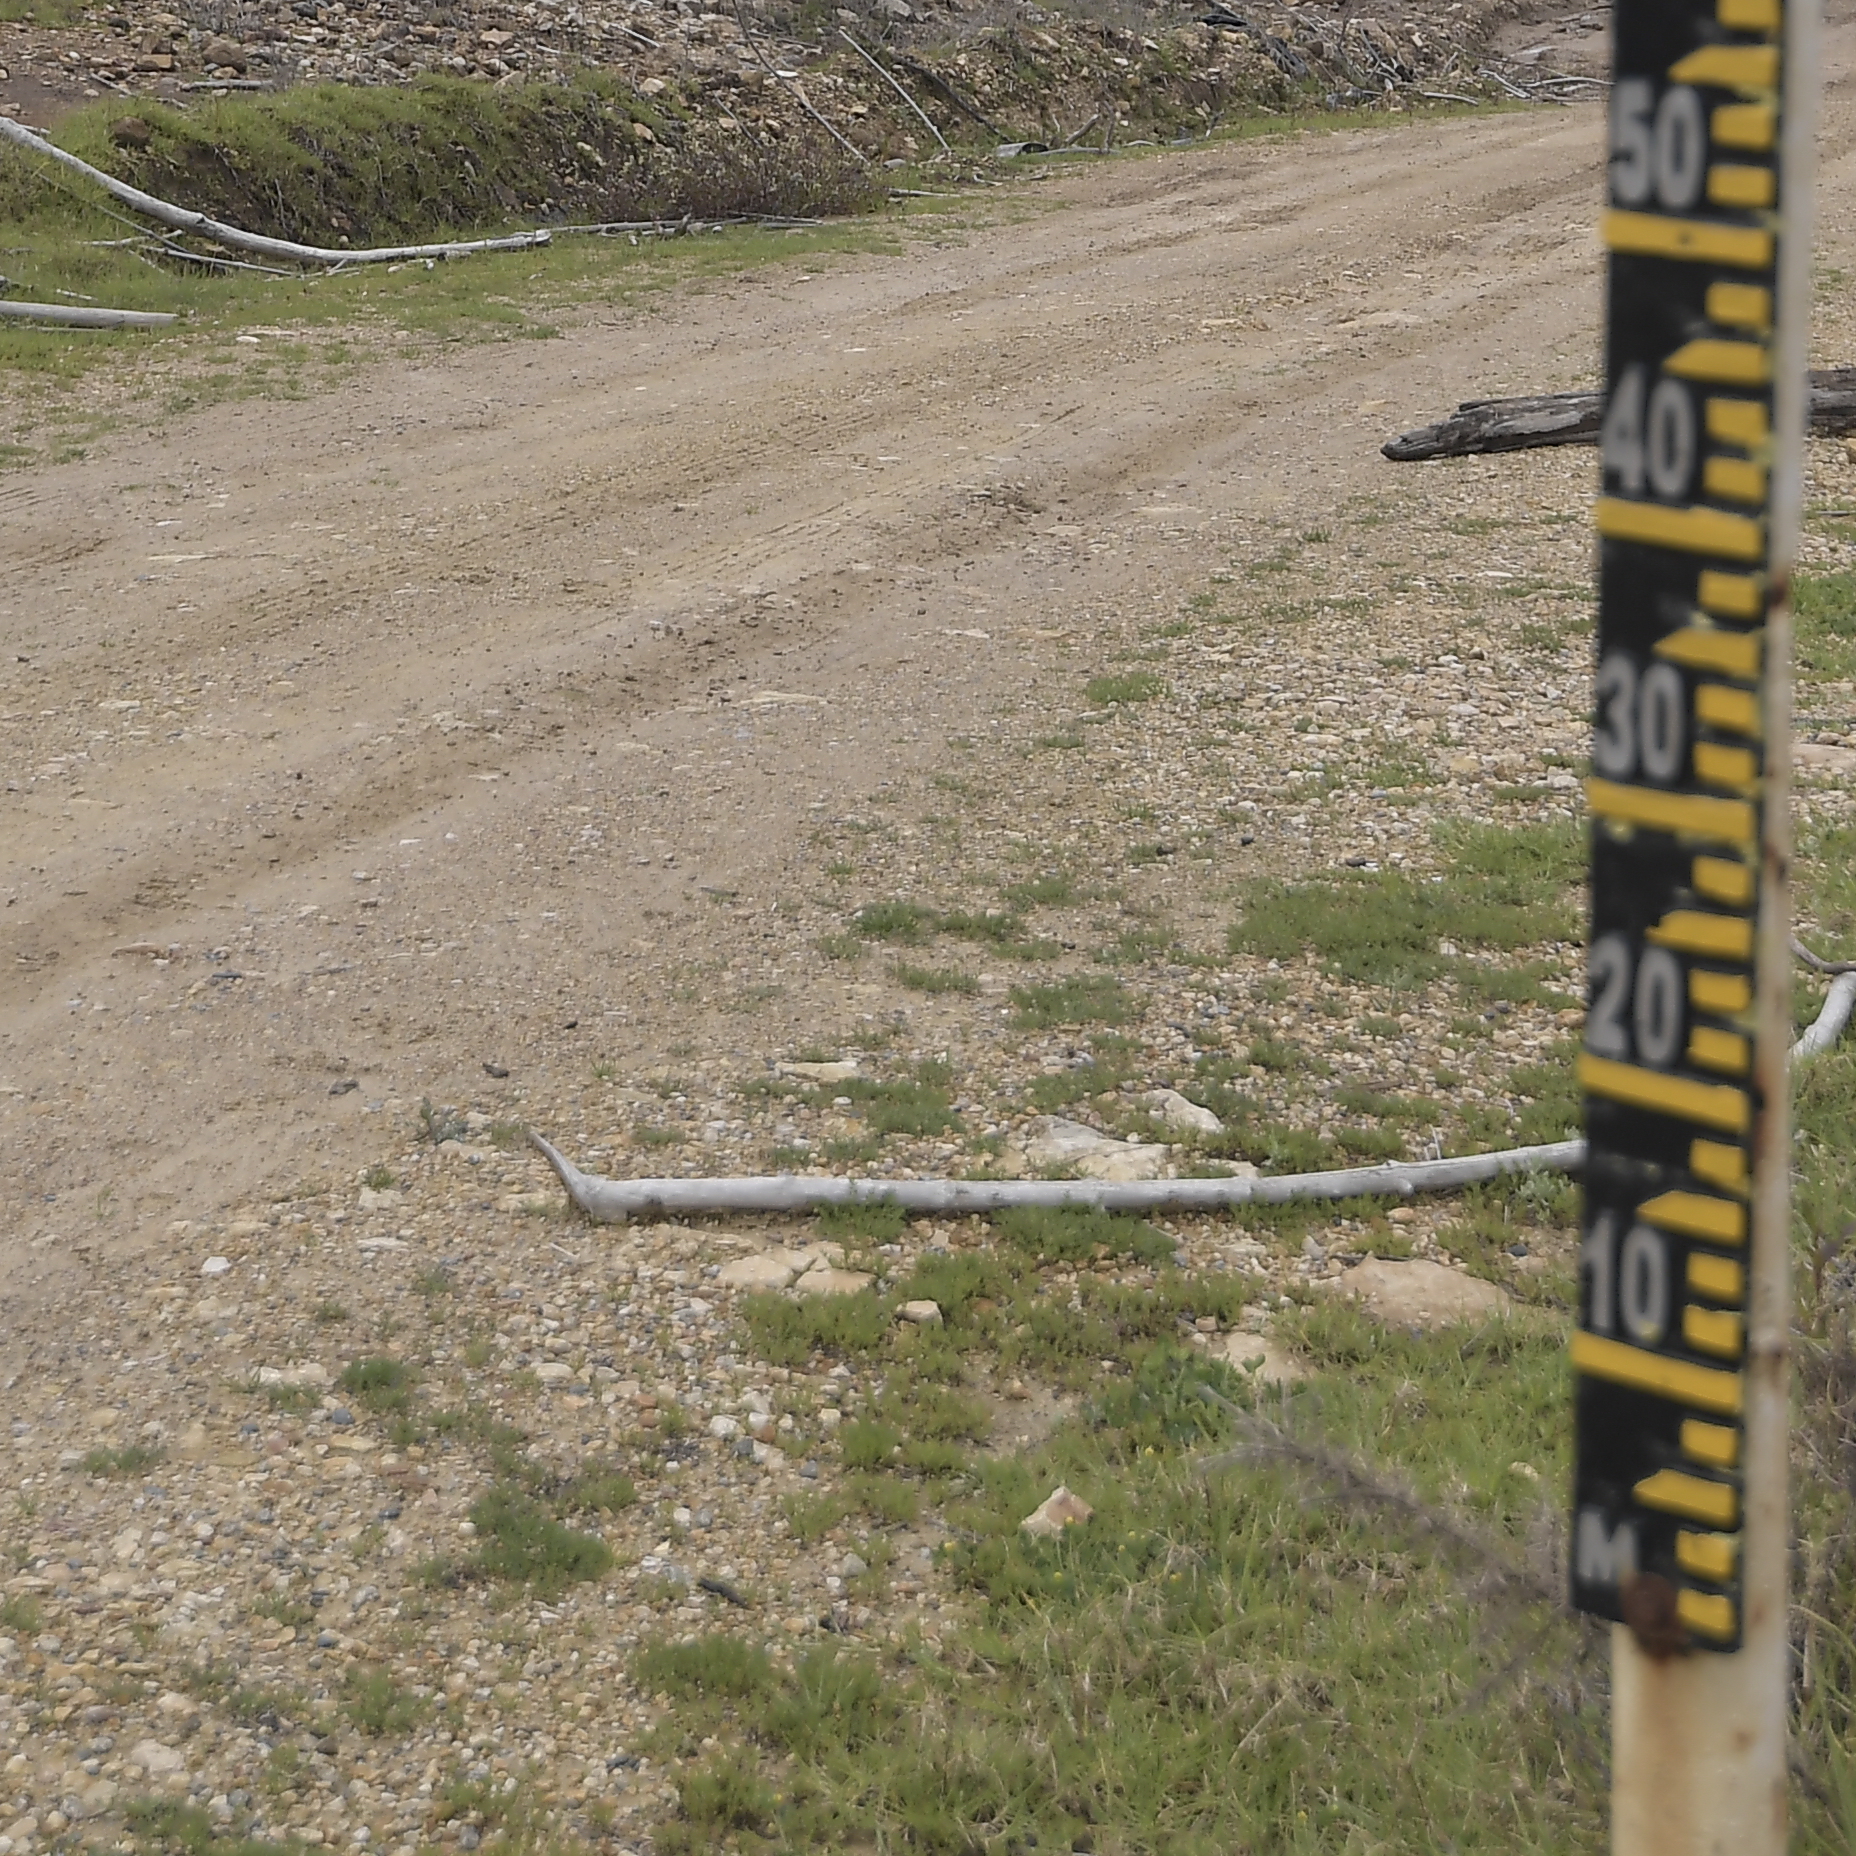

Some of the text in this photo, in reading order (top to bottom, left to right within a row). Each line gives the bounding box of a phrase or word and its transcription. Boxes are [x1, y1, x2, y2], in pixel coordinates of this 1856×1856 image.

[1611, 78, 1705, 210] 50
[1601, 362, 1696, 498] 40
[1597, 652, 1686, 783] 30
[1587, 929, 1682, 1067] 20
[1583, 1207, 1670, 1341] 10
[1576, 1505, 1639, 1587] M
